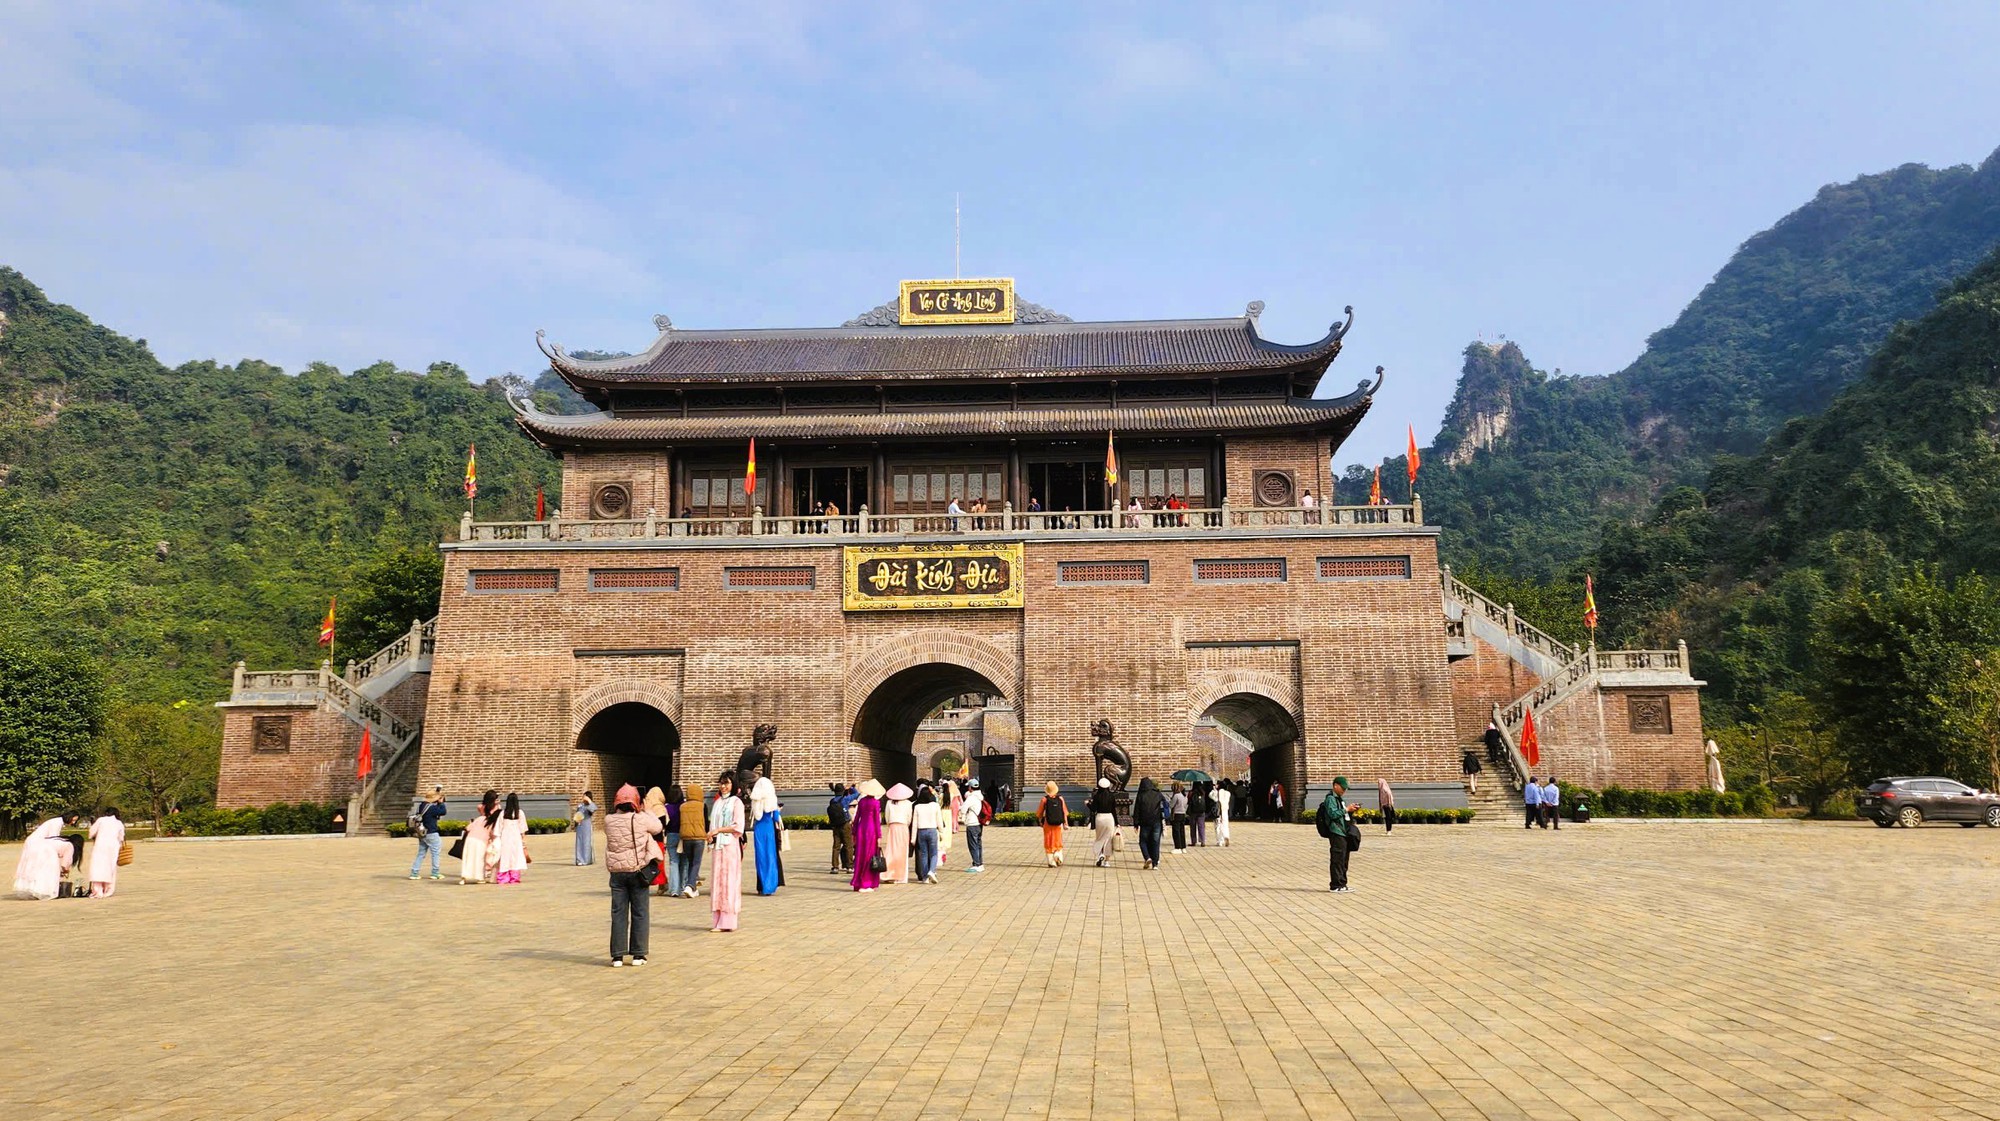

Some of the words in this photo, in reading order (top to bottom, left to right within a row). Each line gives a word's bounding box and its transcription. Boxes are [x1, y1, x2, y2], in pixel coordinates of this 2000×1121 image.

[919, 292, 934, 312] Vạn
[974, 291, 996, 312] Linh
[869, 561, 909, 591] Đài
[960, 560, 1000, 590] Địa
